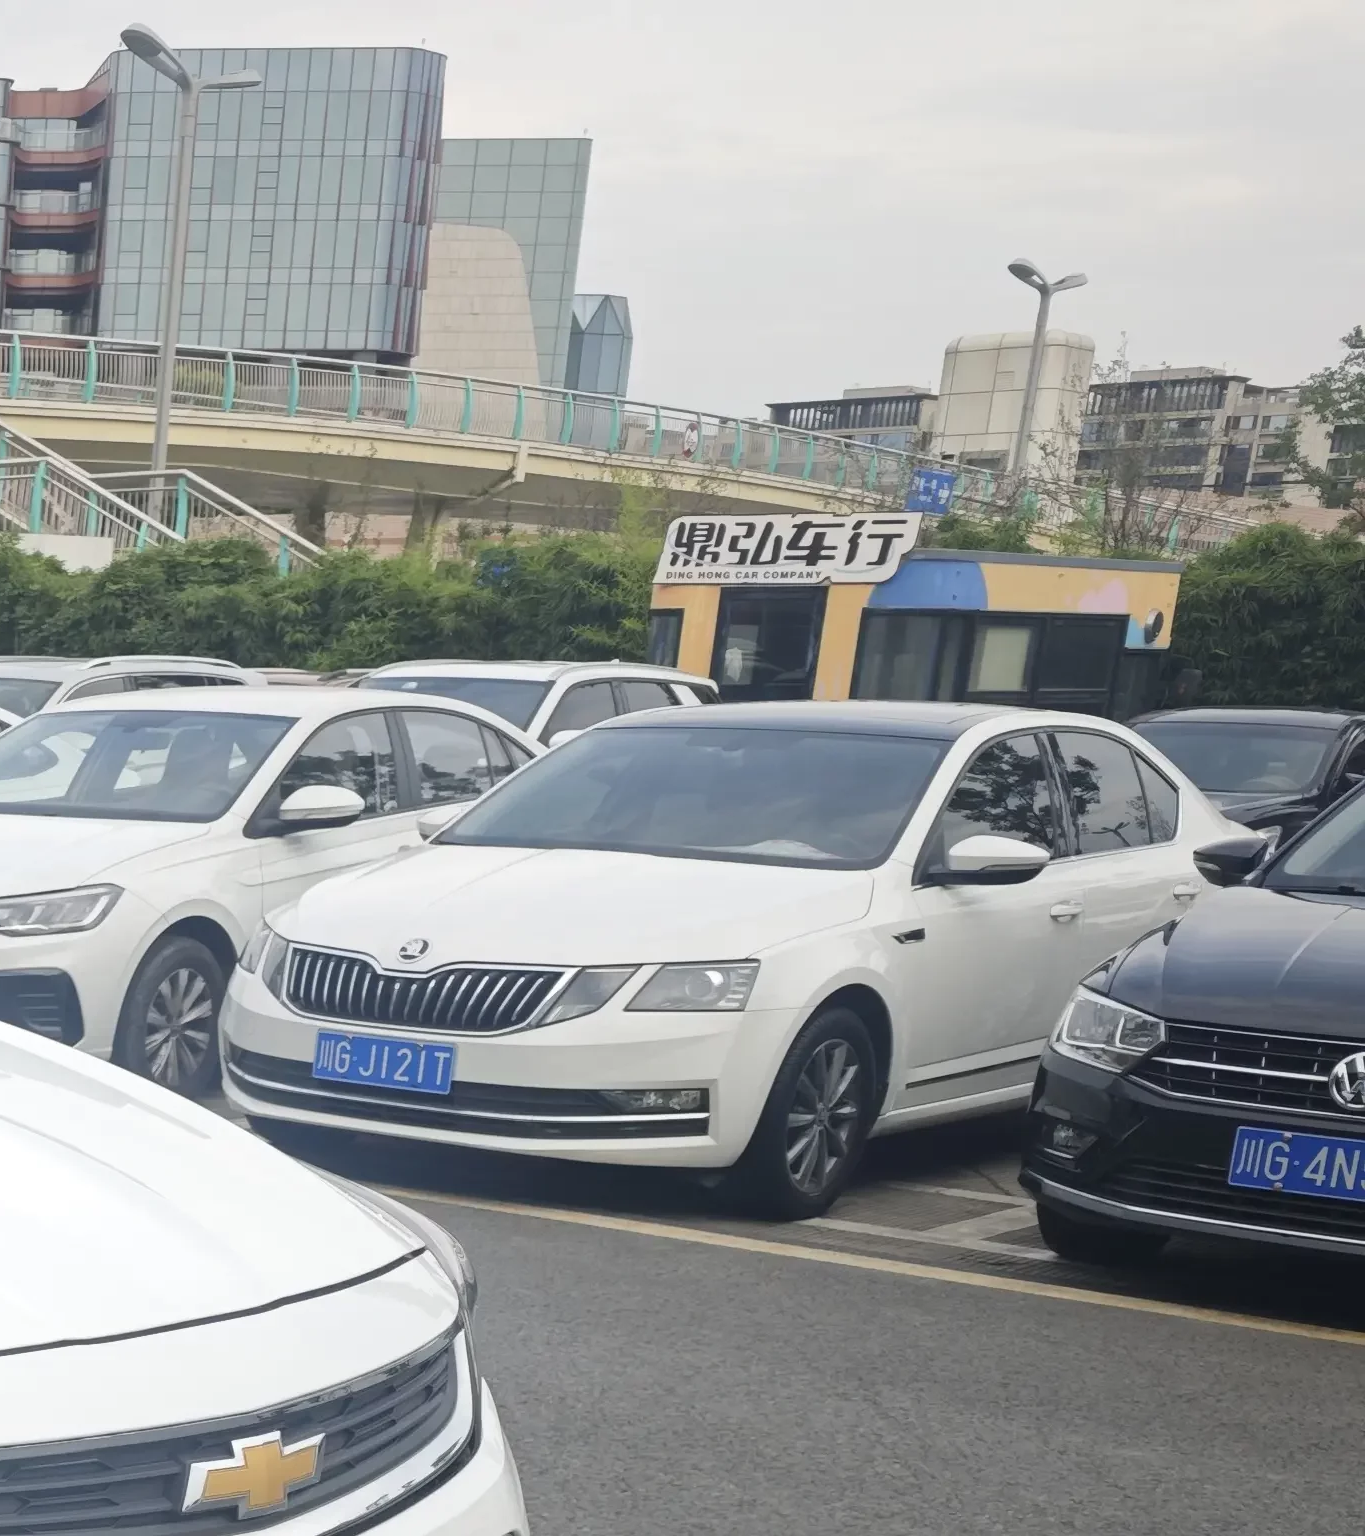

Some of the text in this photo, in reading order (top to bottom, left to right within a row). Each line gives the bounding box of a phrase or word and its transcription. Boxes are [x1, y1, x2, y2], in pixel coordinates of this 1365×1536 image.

[669, 518, 909, 567] 鼎弘车行
[665, 570, 823, 580] DING HONG CAR COMPANY
[1235, 1137, 1365, 1191] 川G·4N
